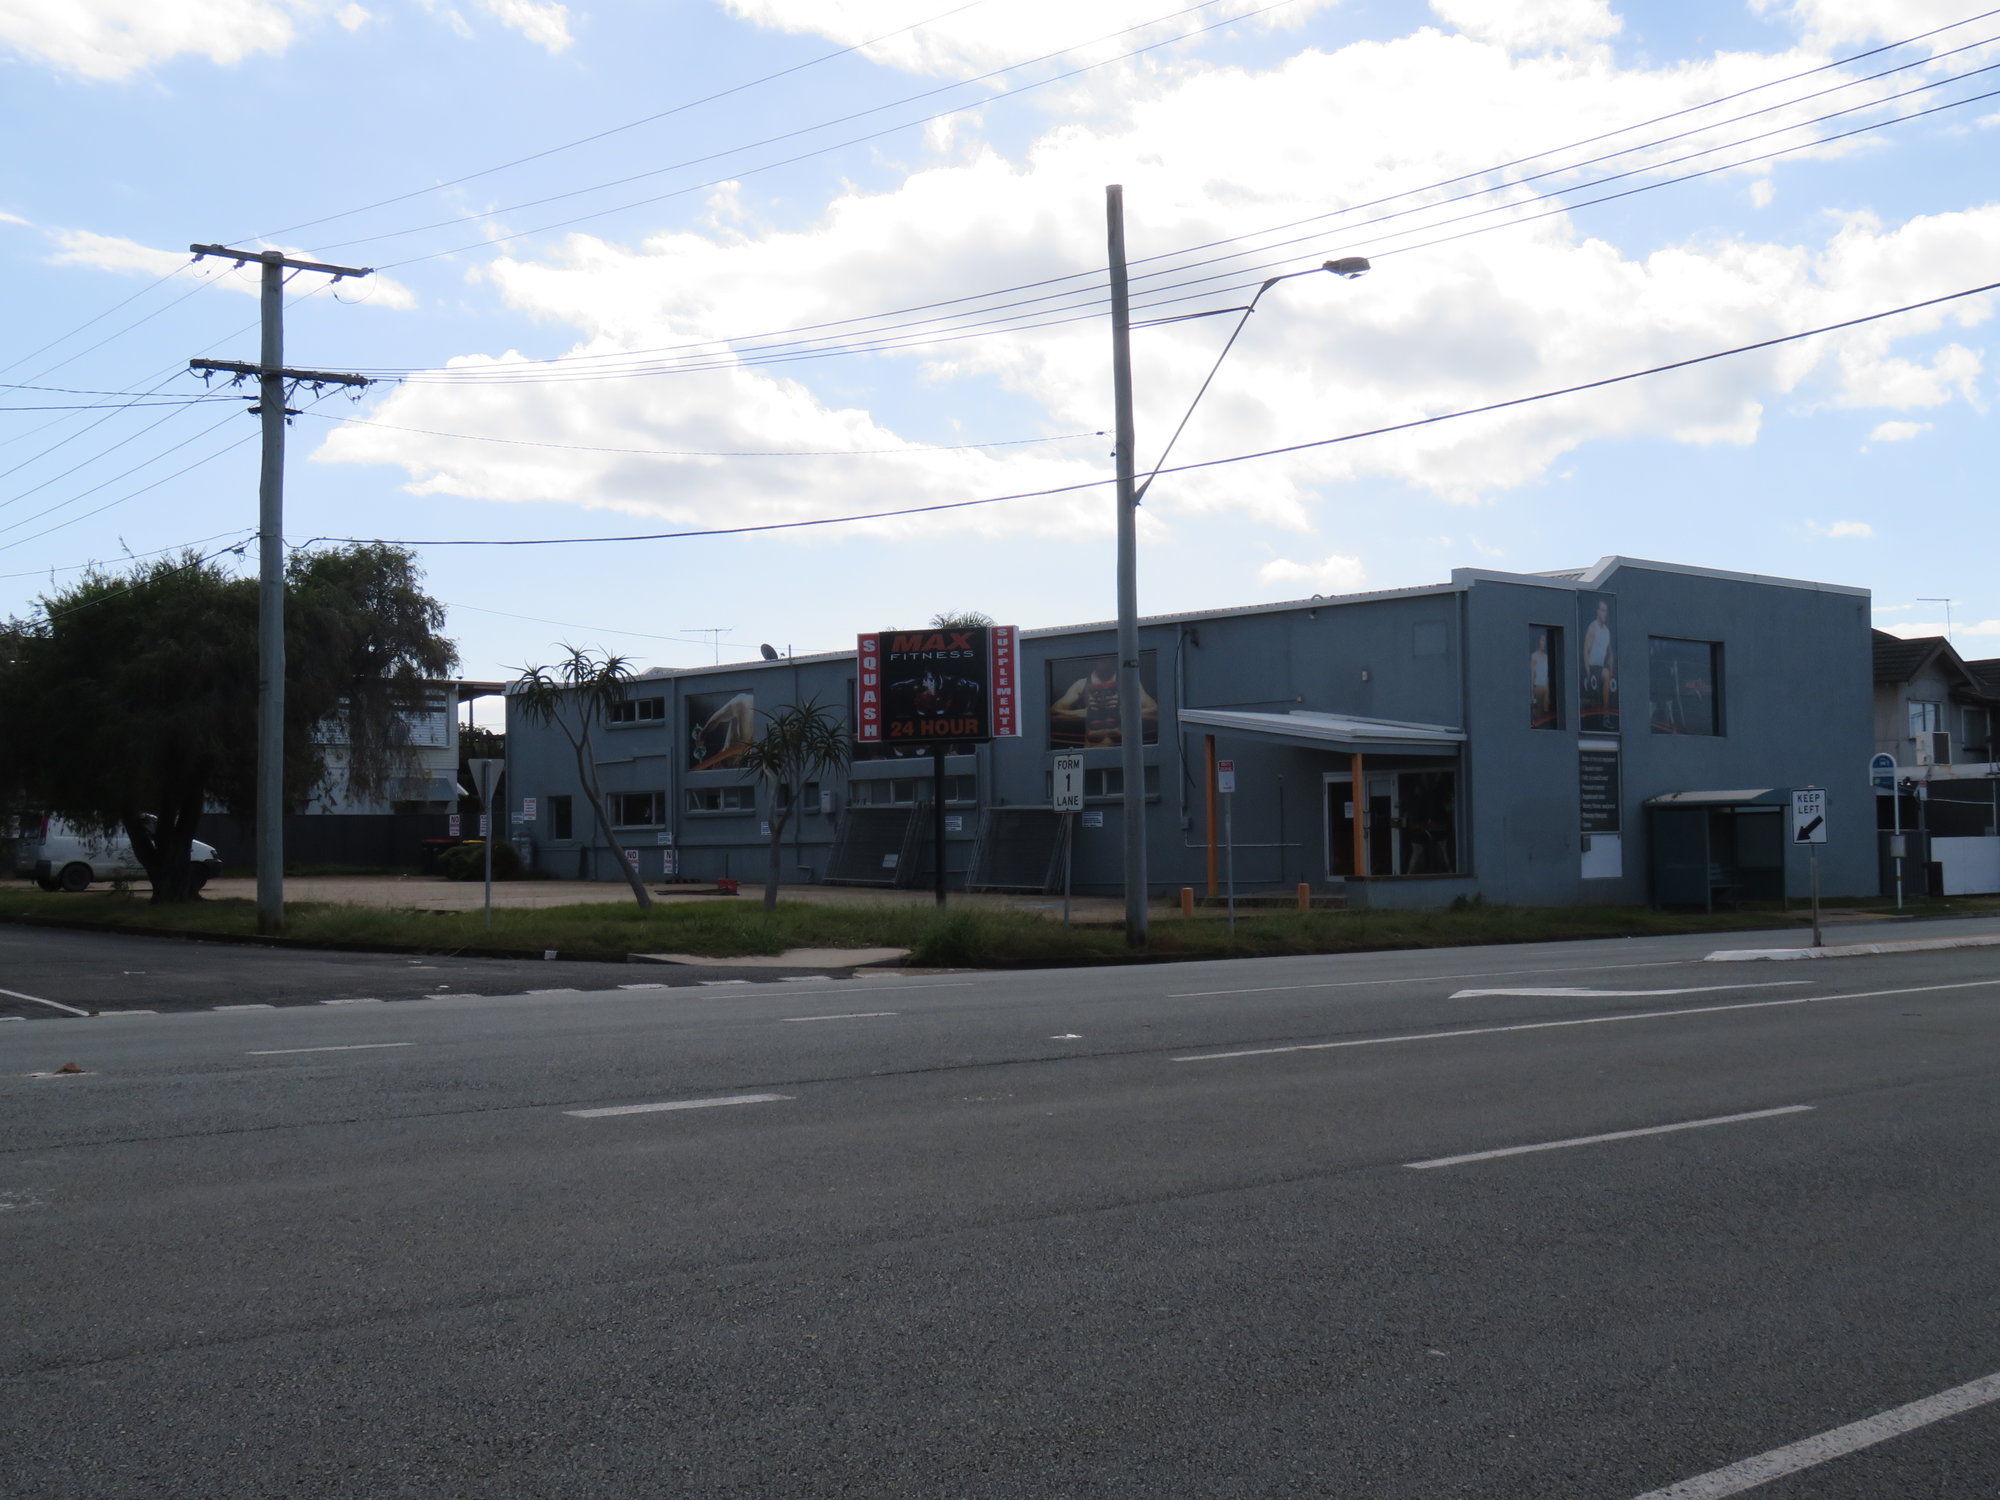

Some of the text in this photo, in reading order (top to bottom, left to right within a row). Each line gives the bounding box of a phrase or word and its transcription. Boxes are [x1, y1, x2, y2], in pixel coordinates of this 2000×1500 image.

[891, 632, 974, 652] MAX
[890, 650, 974, 661] FITNESS
[863, 639, 877, 737] SQUASH
[996, 627, 1011, 735] SUPPLEMENTS
[890, 718, 980, 737] 24 HOUR
[1057, 759, 1080, 770] FORM
[1066, 773, 1071, 793] 1
[1057, 795, 1079, 807] LANE
[1797, 794, 1820, 803] KEEP
[1798, 805, 1820, 814] LEFT
